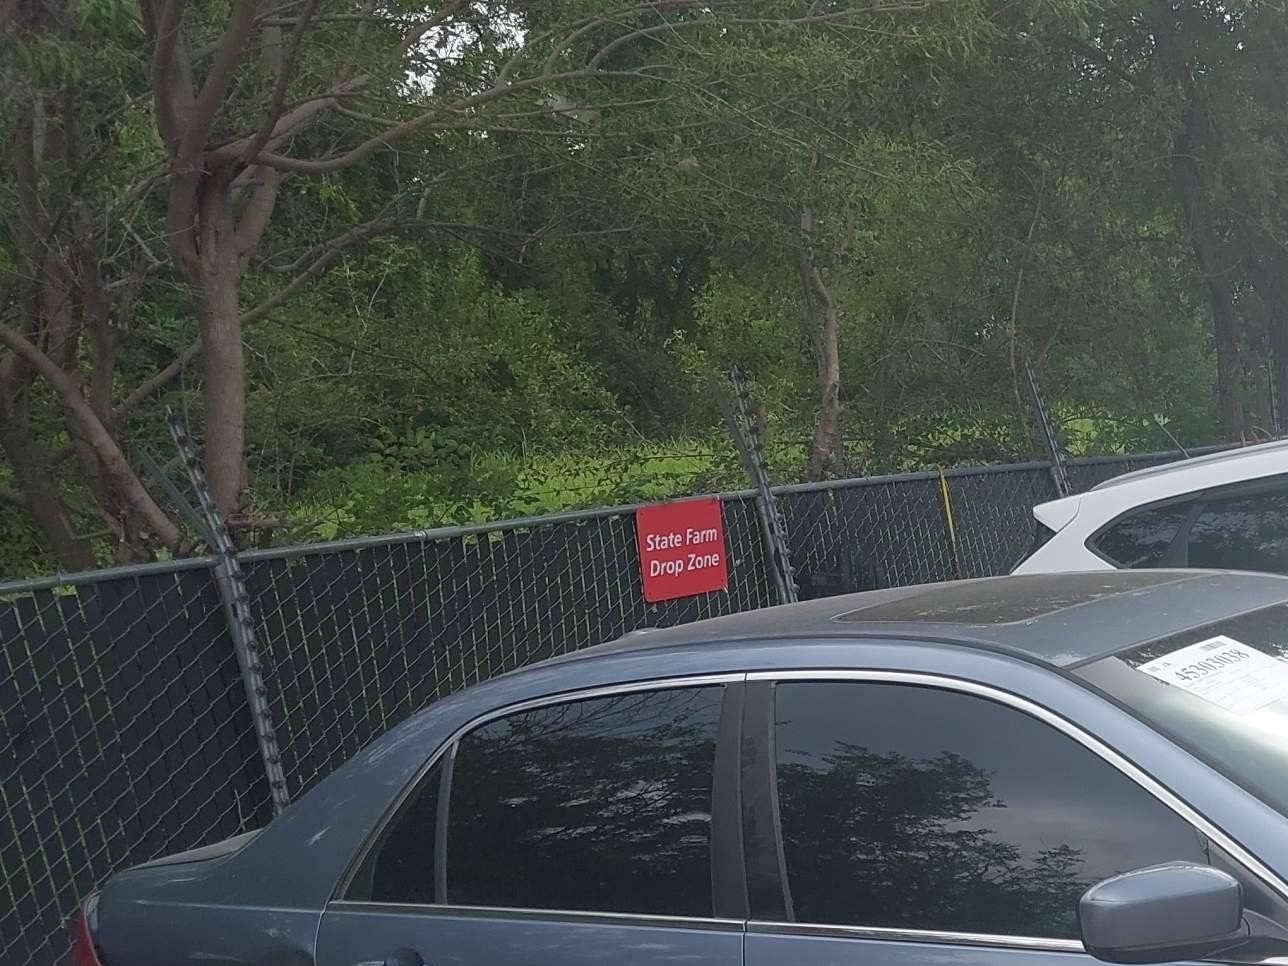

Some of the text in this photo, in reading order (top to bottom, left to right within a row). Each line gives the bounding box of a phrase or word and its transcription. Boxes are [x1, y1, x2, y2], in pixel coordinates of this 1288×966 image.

[646, 528, 718, 552] State Farm
[650, 553, 720, 577] Drop Zone
[1174, 649, 1250, 682] 45303038
